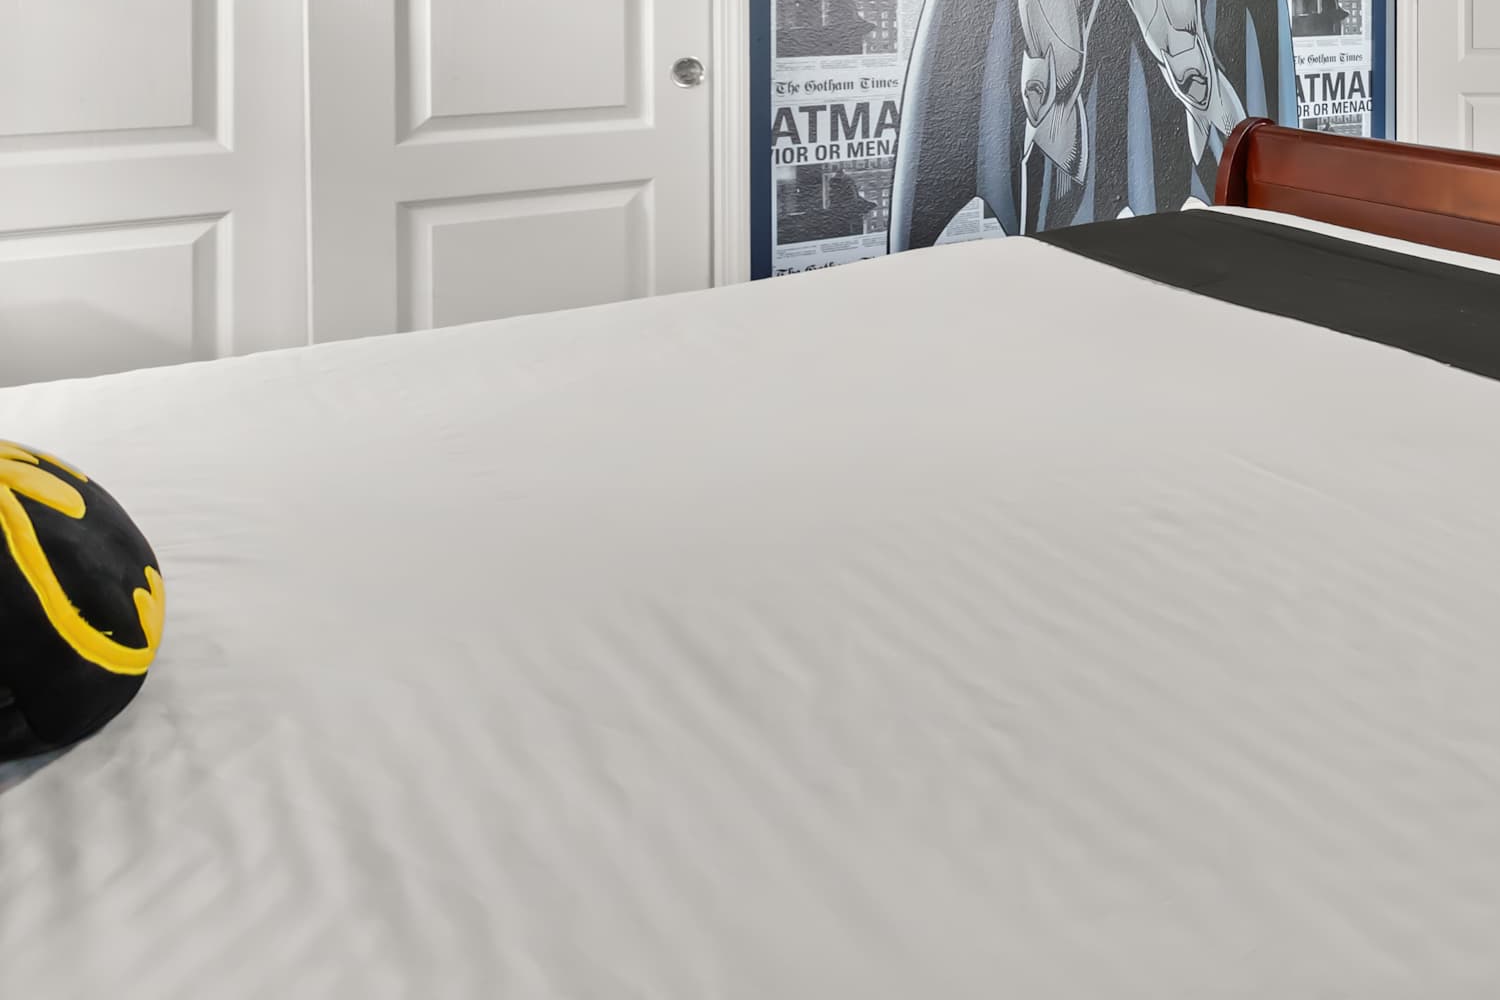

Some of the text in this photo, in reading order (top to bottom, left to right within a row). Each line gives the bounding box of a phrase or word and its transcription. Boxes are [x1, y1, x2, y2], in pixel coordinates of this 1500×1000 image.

[1307, 53, 1337, 65] Gotham
[1339, 52, 1364, 63] Times
[775, 76, 900, 98] The Gotham Times
[1313, 103, 1329, 116] OR
[772, 146, 808, 165] IOR
[815, 143, 840, 161] OR
